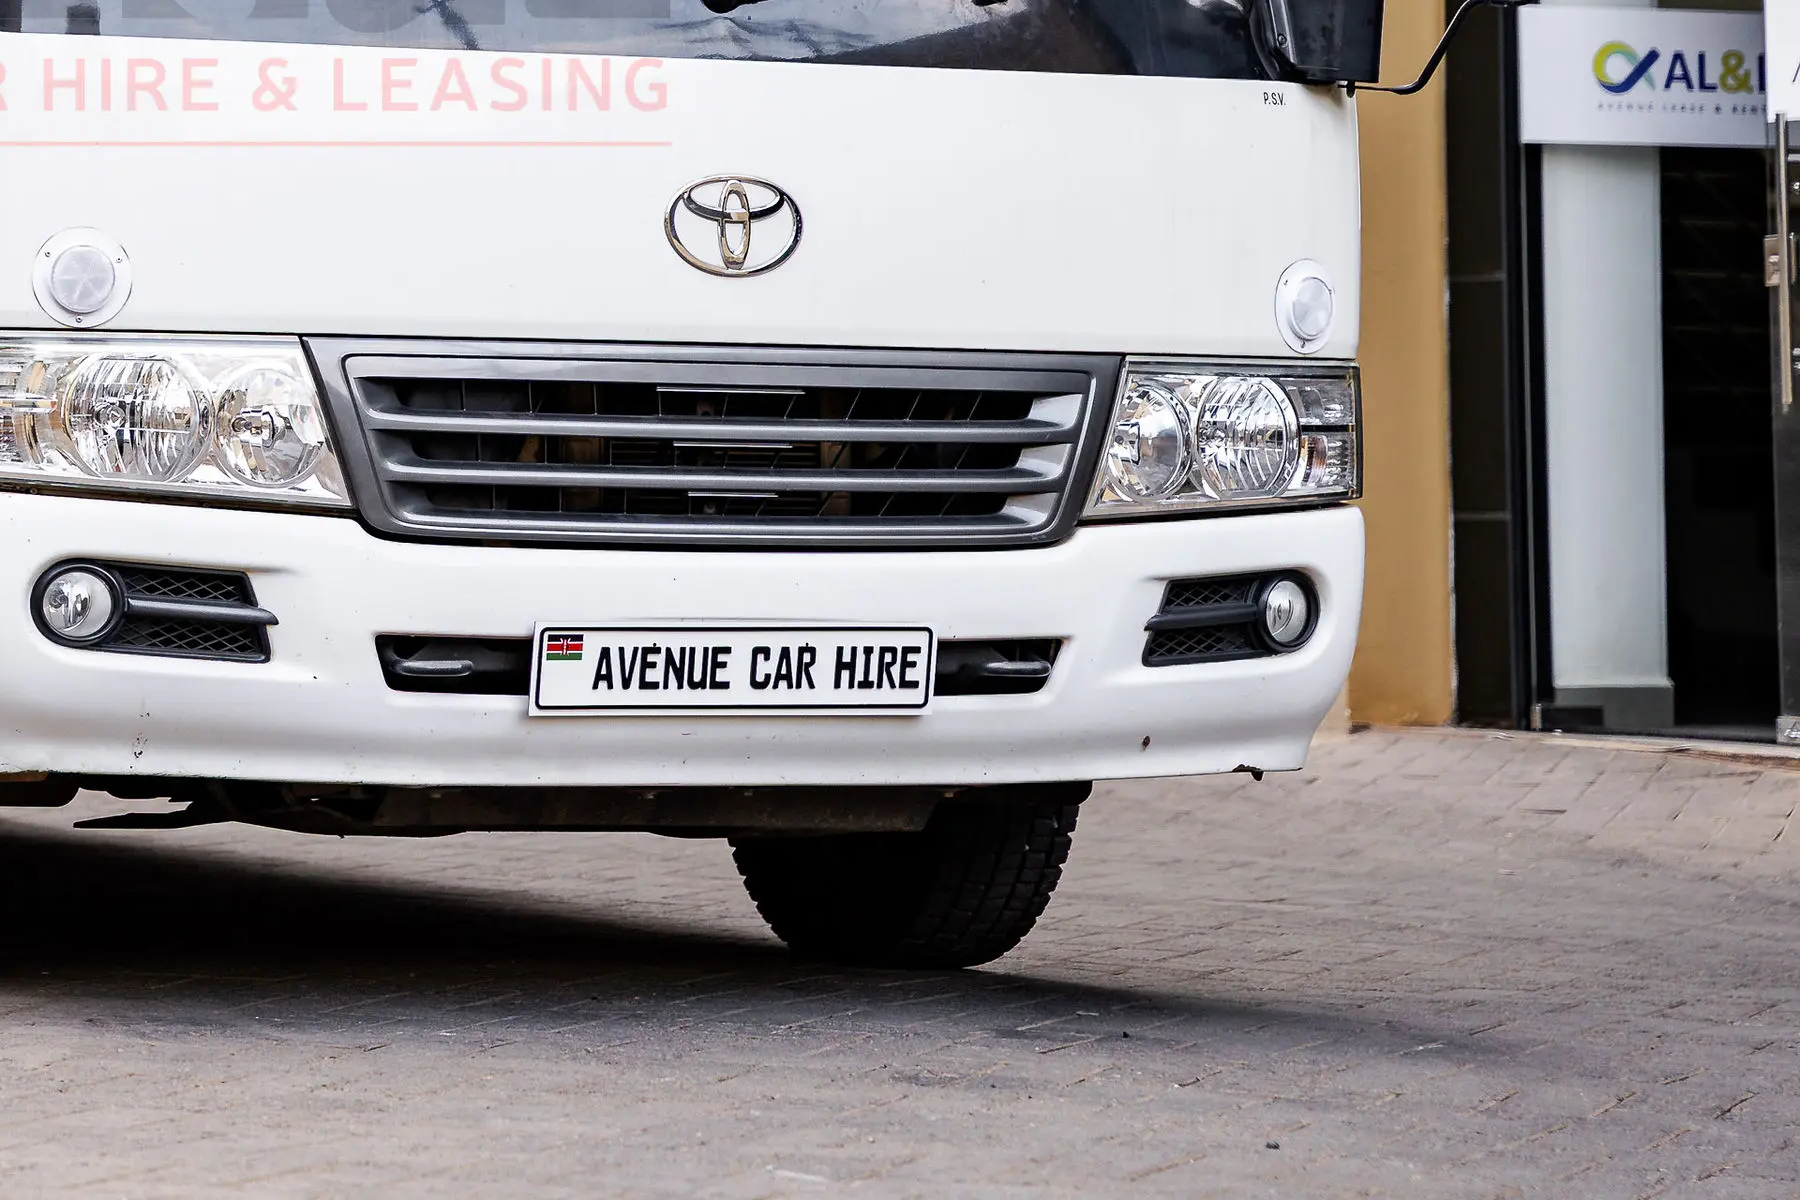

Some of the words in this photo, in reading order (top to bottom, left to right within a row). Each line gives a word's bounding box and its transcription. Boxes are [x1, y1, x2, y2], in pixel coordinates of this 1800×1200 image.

[1663, 50, 1767, 93] AL&
[591, 645, 732, 691] AVENUE
[748, 645, 817, 690] CAR
[832, 645, 922, 690] HIRE
